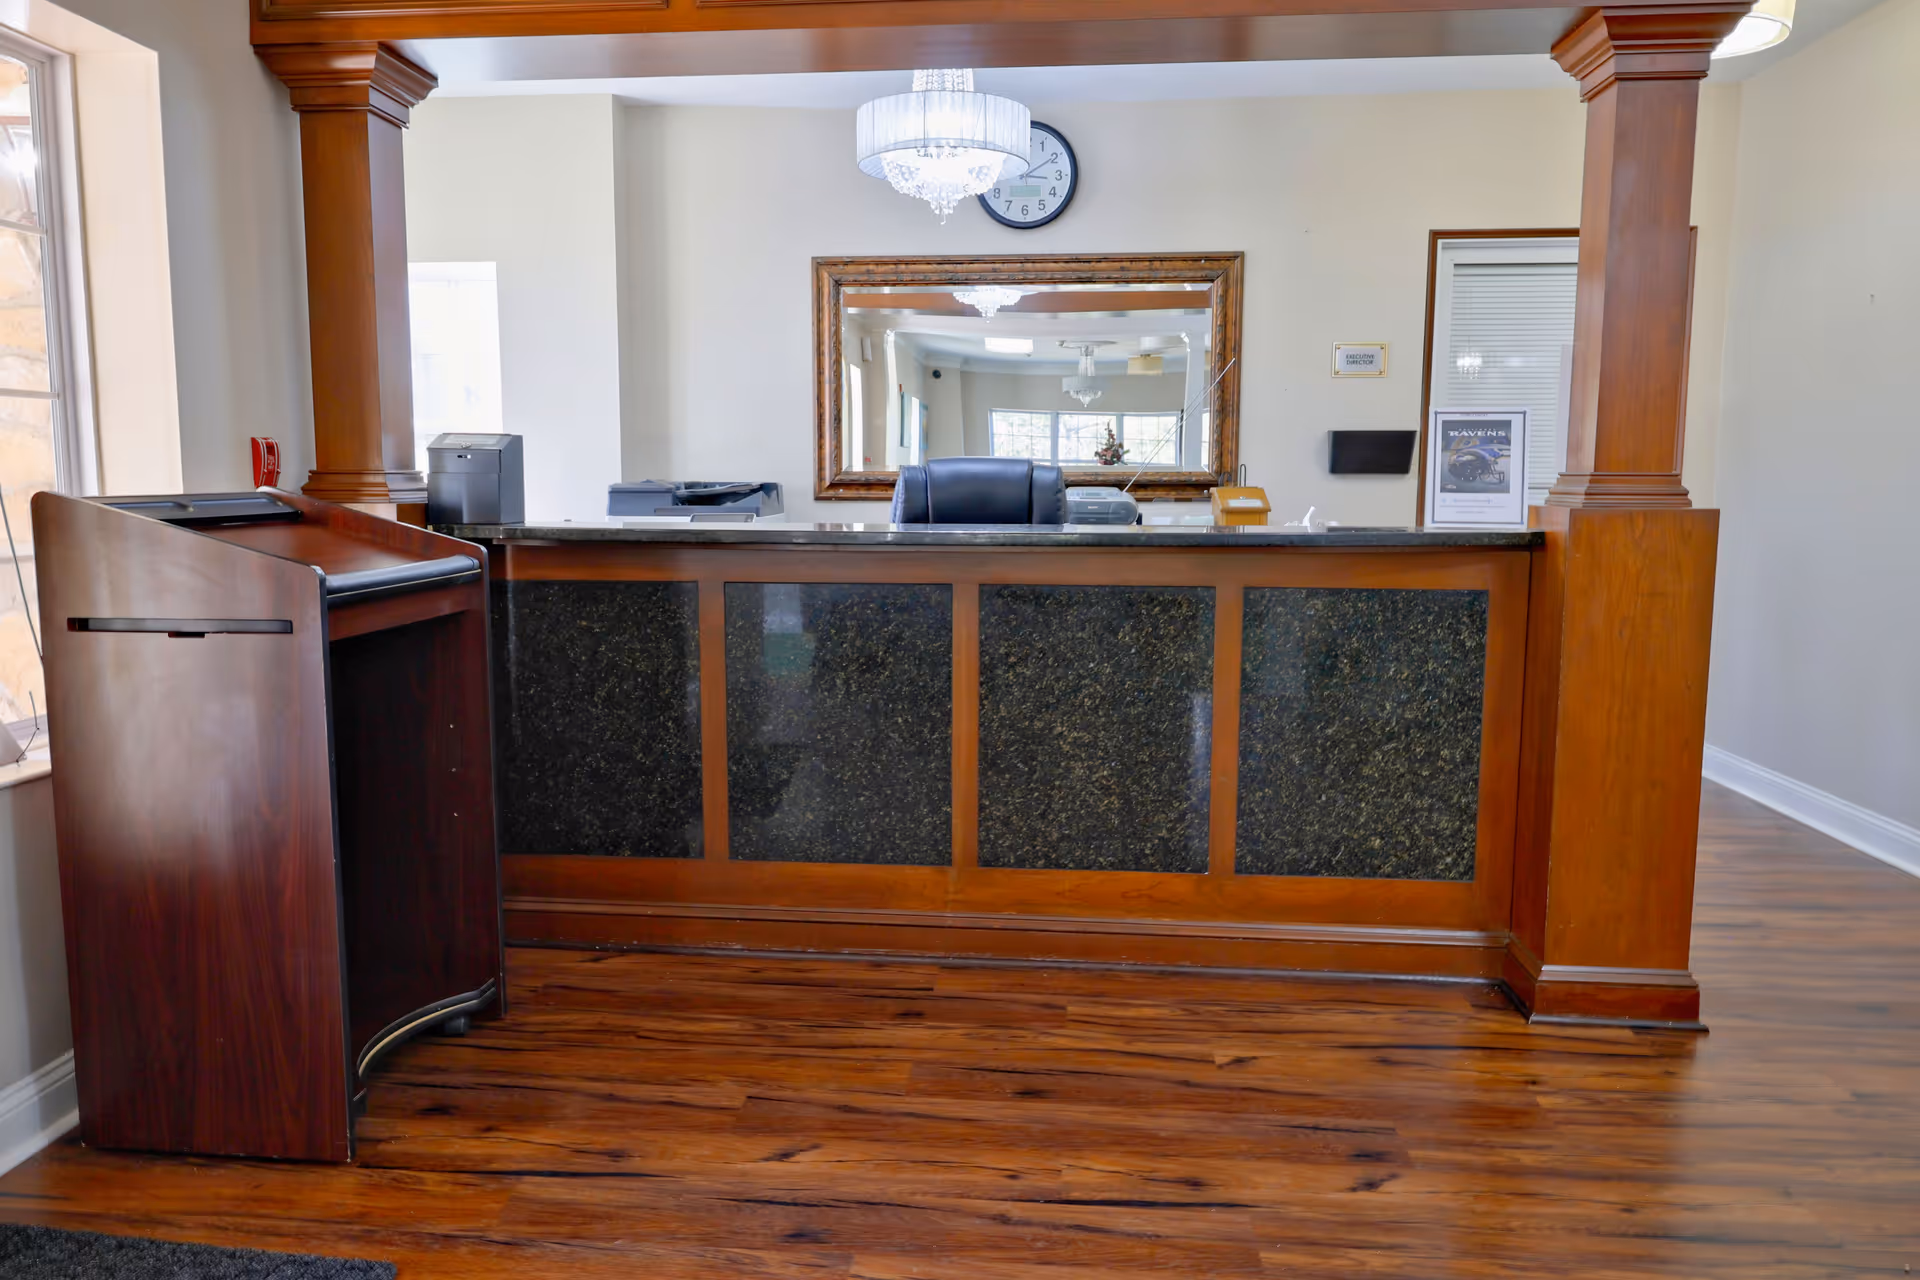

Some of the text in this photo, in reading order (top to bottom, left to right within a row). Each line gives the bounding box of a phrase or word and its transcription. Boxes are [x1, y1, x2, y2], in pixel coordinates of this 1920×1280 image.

[1050, 152, 1058, 163] 2
[1055, 169, 1062, 181] 3
[993, 188, 1001, 199] 8
[1048, 186, 1056, 198] 4
[1004, 200, 1012, 211] 7
[1021, 204, 1029, 216] 6
[1038, 199, 1045, 211] 5
